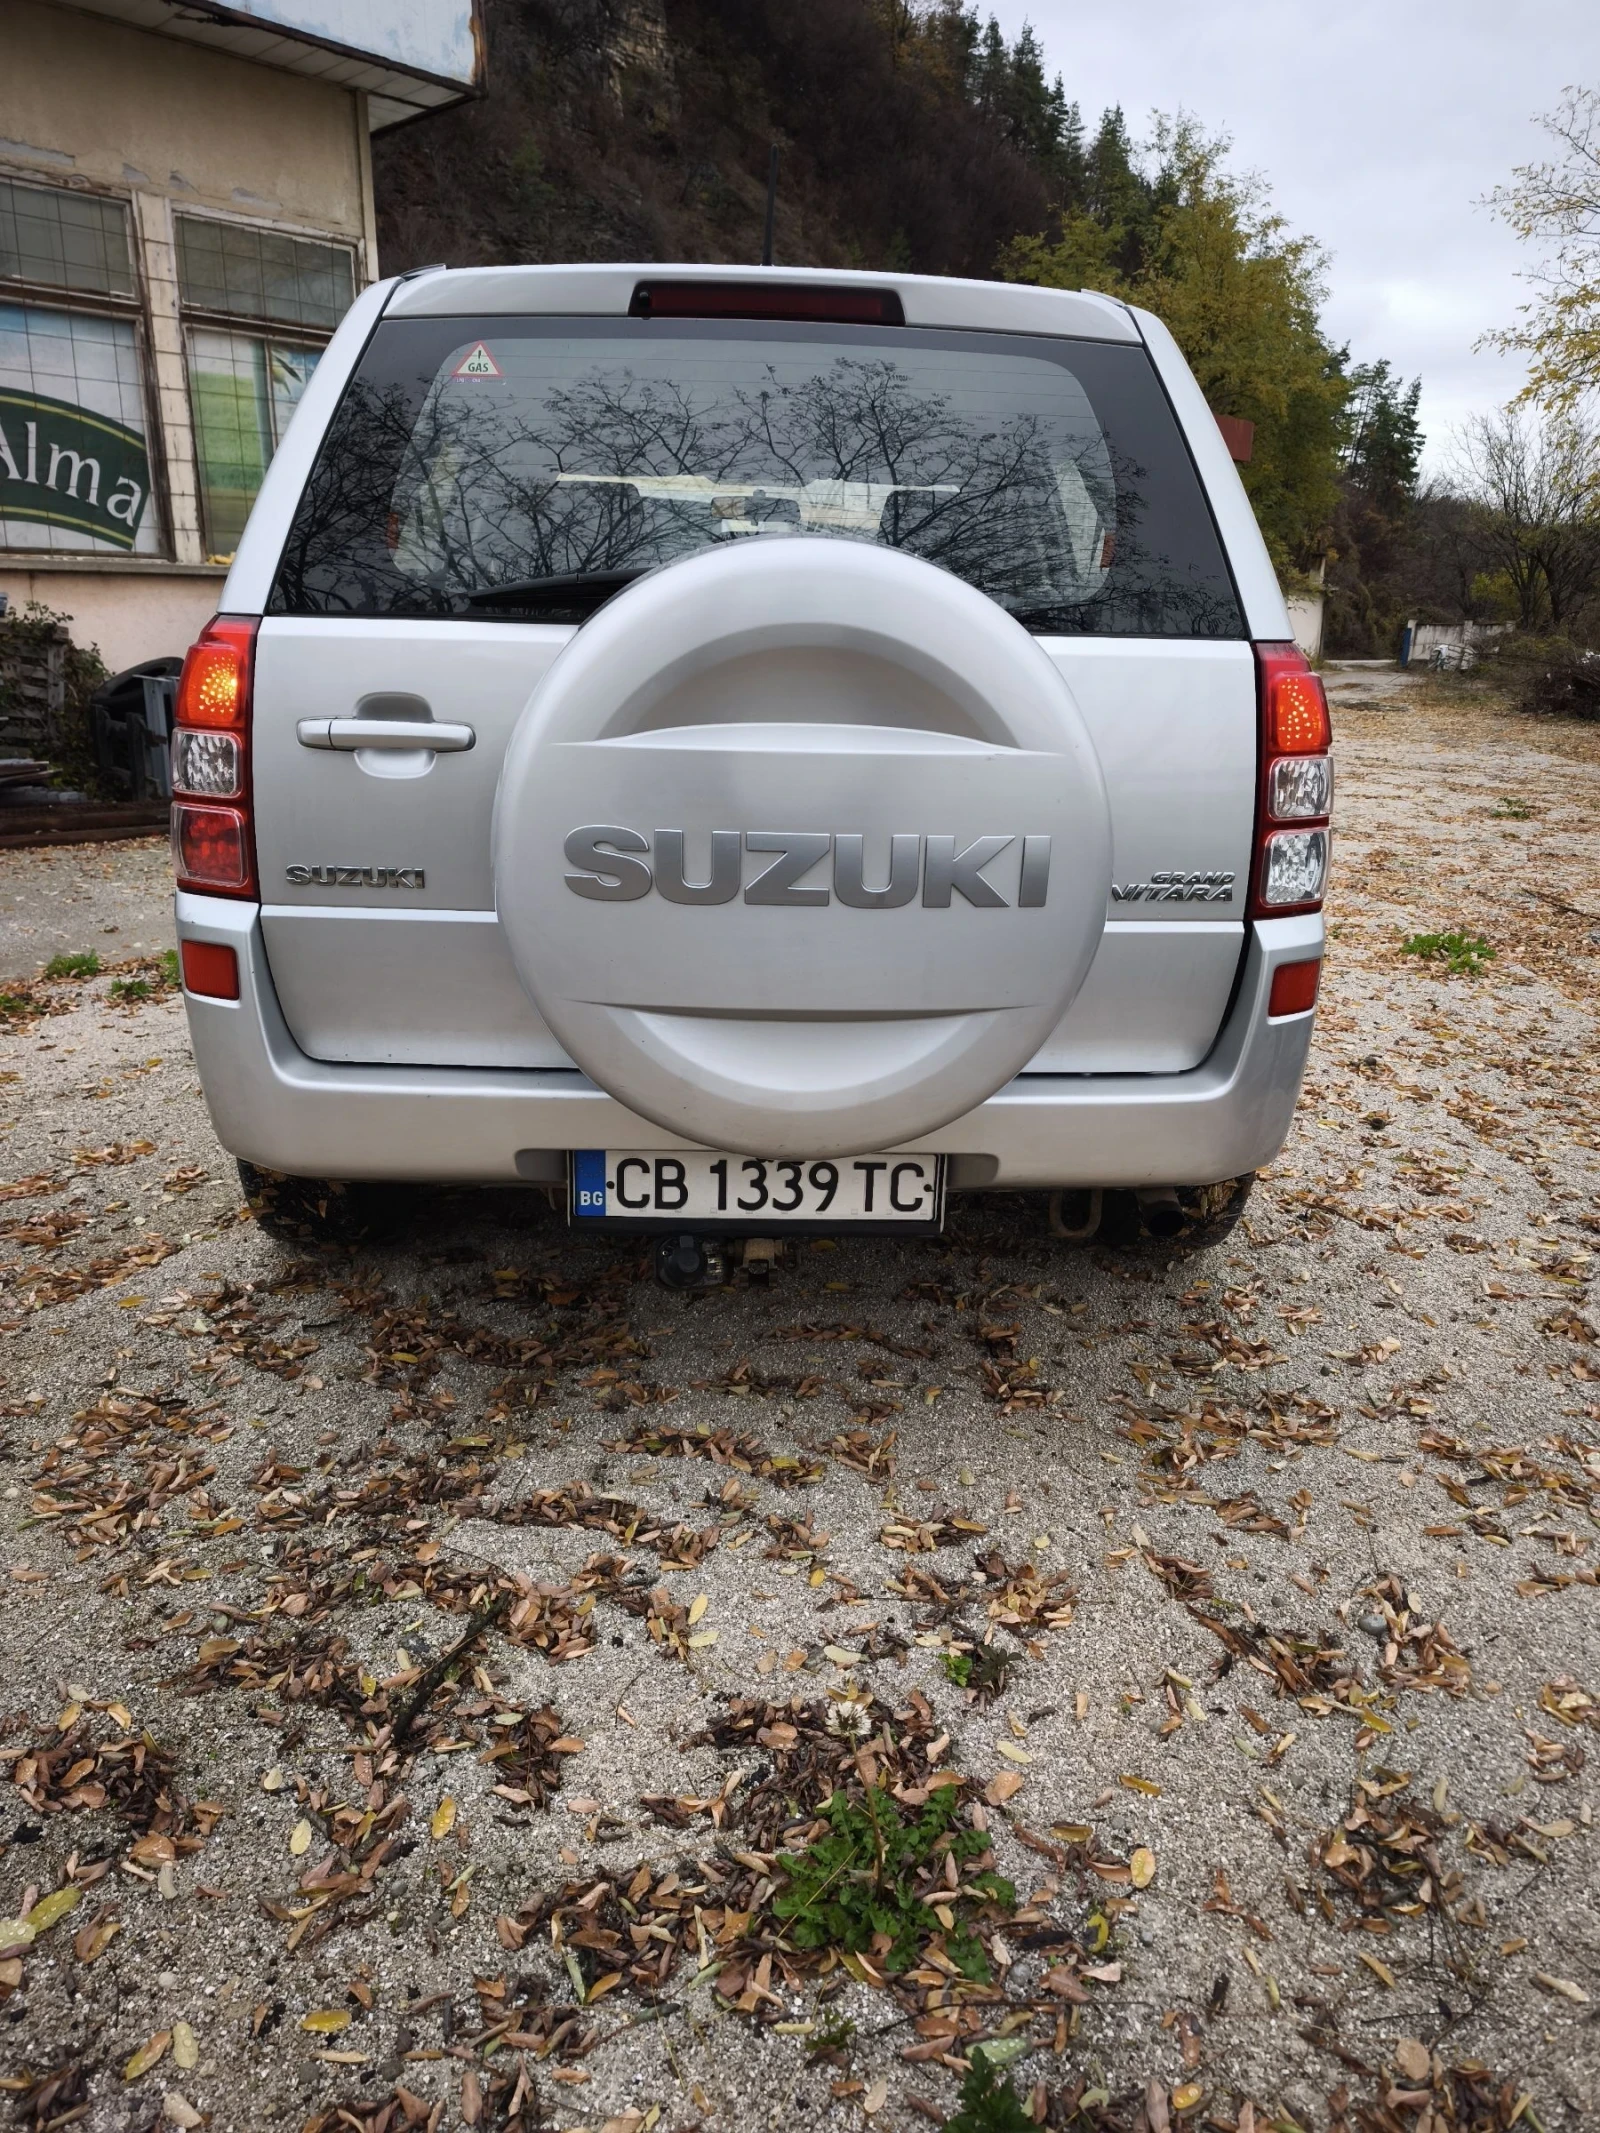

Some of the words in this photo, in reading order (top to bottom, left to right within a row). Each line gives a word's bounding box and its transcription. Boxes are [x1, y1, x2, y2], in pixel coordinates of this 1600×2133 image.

[468, 362, 489, 373] GAS
[564, 824, 1052, 909] SUZUKI
[286, 864, 426, 889] SUZUKI
[1151, 871, 1236, 884] GRAND
[1111, 884, 1233, 902] VITARA
[616, 1157, 689, 1211] CB
[709, 1159, 839, 1213] 1339
[853, 1162, 926, 1213] TC
[580, 1190, 604, 1206] BG
